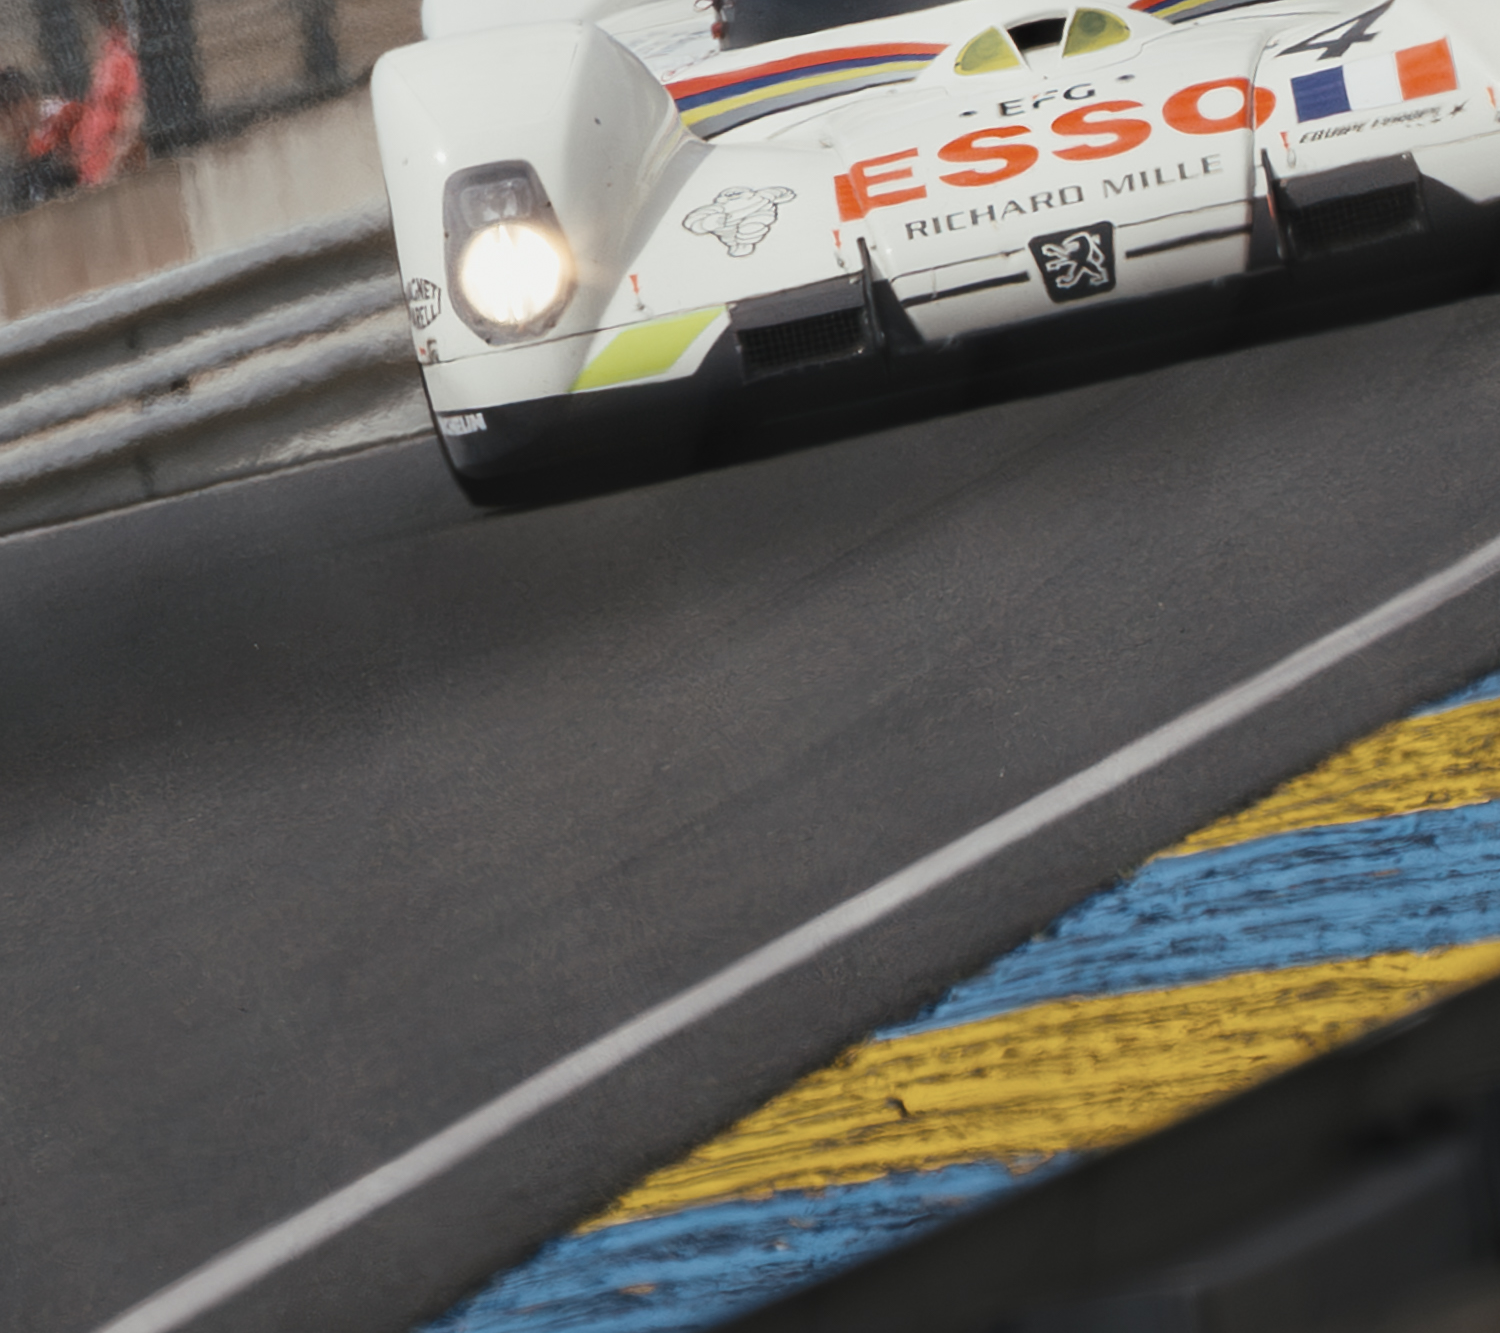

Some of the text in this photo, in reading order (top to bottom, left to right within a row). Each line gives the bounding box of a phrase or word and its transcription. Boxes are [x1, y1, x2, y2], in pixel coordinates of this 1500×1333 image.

[1000, 82, 1097, 118] EFG
[833, 76, 1277, 222] ESSO
[904, 153, 1224, 240] RICHARD MILLE
